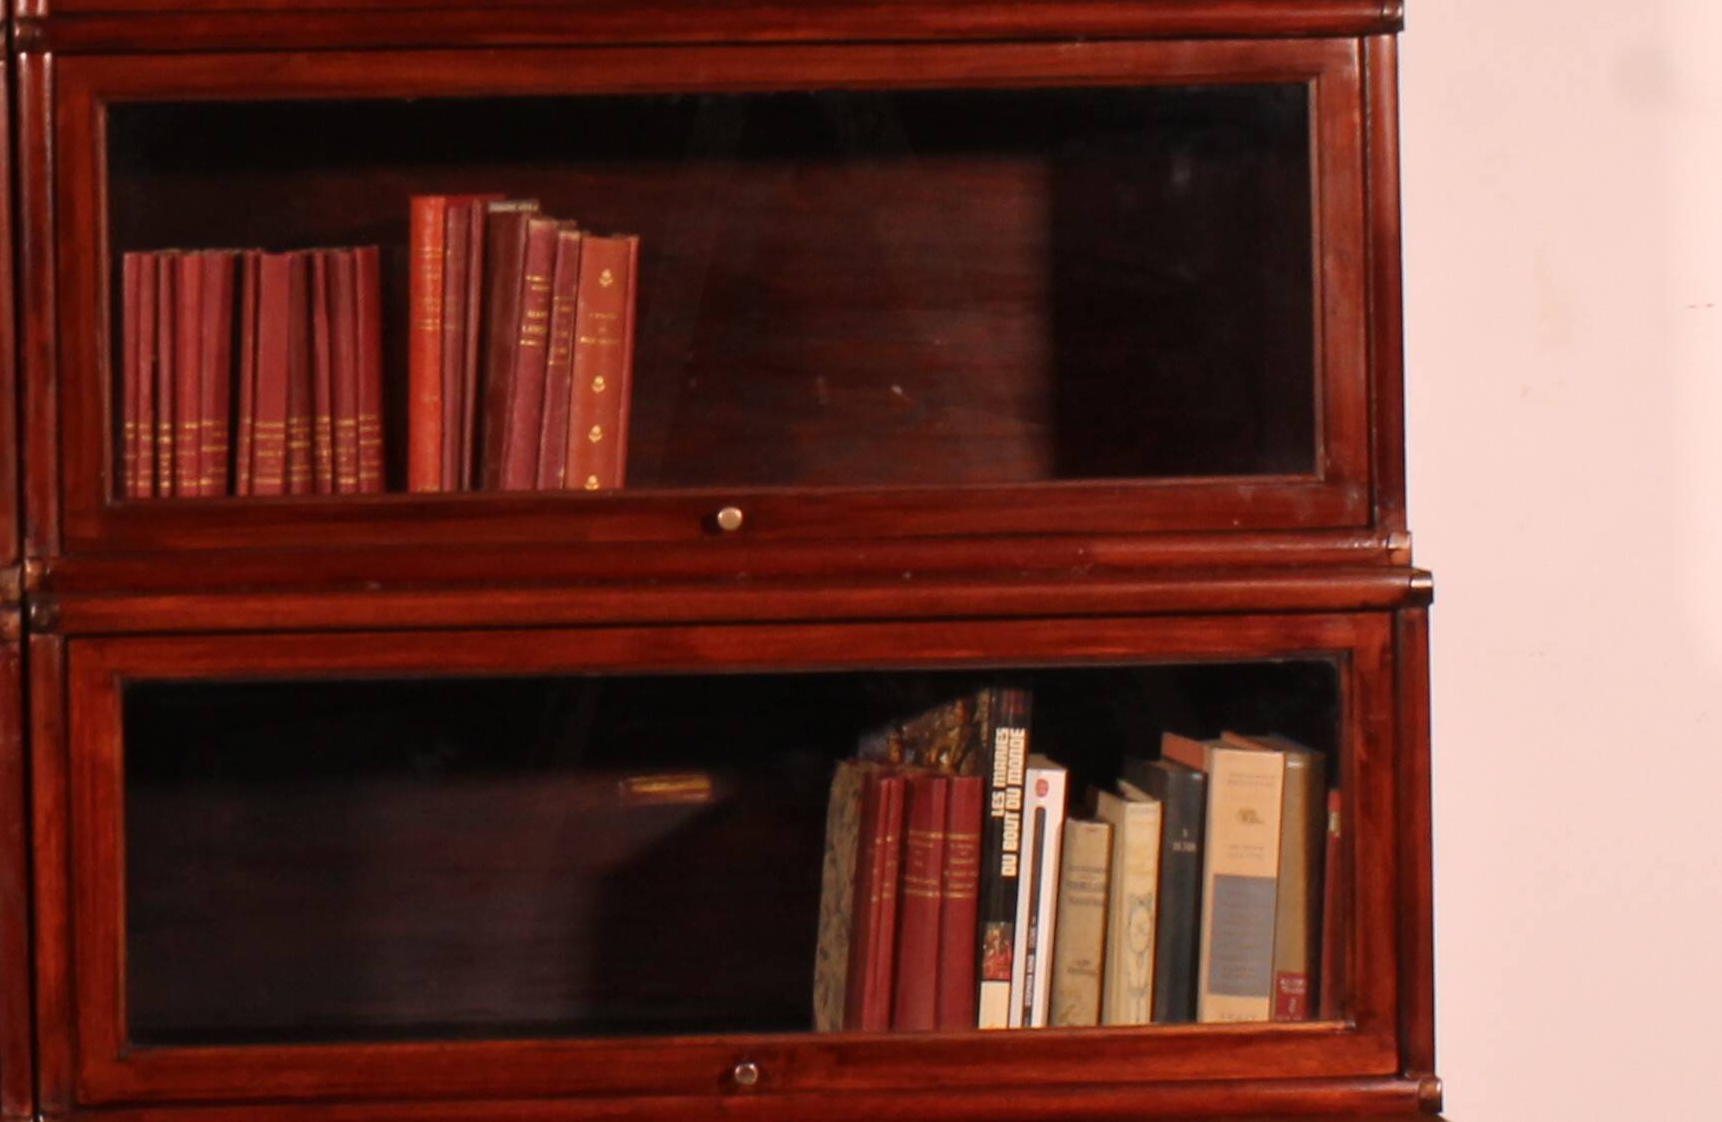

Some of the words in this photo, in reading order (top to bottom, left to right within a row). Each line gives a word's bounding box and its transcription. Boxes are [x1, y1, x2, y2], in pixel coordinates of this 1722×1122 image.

[1007, 728, 1025, 785] MONDE
[990, 792, 1006, 819] LES
[1005, 788, 1022, 810] DU
[1002, 811, 1020, 852] BOUT
[1001, 854, 1017, 877] DU
